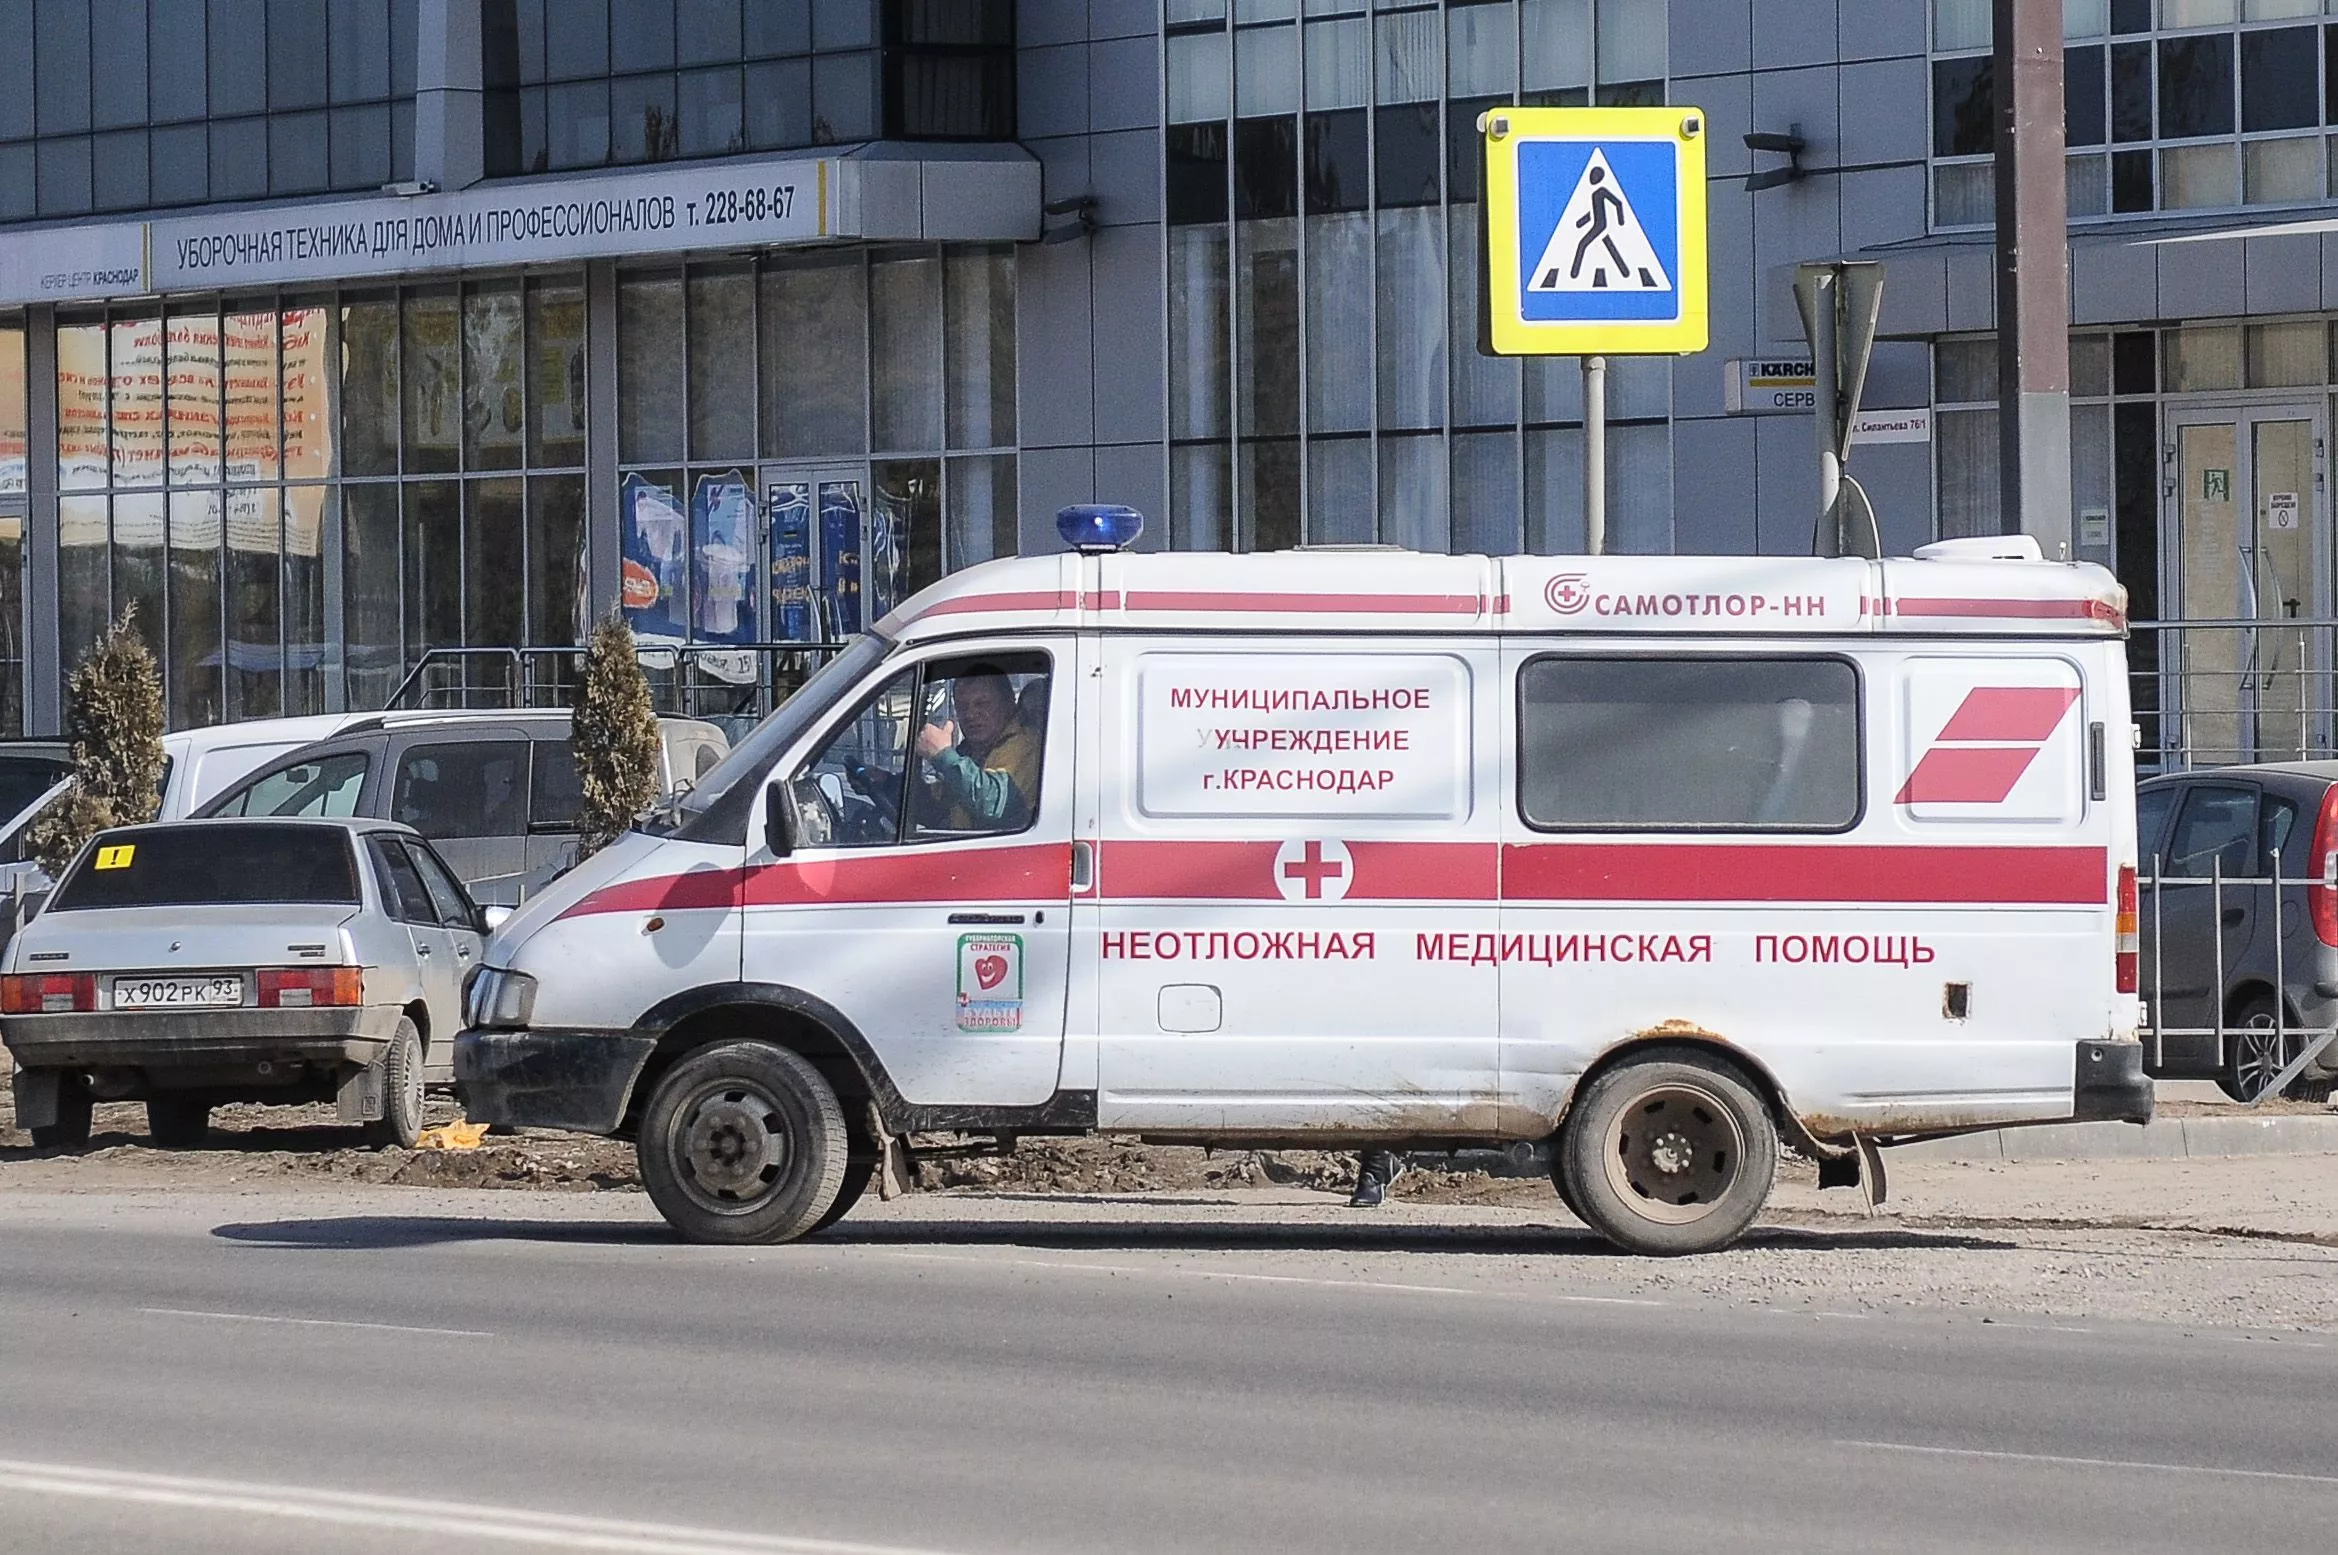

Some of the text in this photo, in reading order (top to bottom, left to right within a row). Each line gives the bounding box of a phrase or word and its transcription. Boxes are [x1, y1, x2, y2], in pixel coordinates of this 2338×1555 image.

[177, 186, 795, 270] УБОРОЧНАЯ ТЕХНИКА ДЛЯ ДОМА И ПРОФЕССИОНАЛОВ т. 228-68-67
[94, 268, 139, 287] КРАСНОДАР
[1761, 362, 1816, 377] KÄRCH
[1773, 391, 1816, 407] СЕРВ
[1594, 594, 1825, 617] САМОТЛОР-НН
[1170, 688, 1430, 713] МУНИЦИПАЛЬНОЕ
[1214, 729, 1410, 754] УЧРЕЖДЕНИЕ
[1202, 769, 1395, 794] г.КРАСНОДАР
[970, 943, 1011, 952] СТРАТЕГИЯ
[1101, 931, 1936, 969] НЕОТЛОЖНАЯ МЕДИЦИНСКАЯ ПОМОЩЬ
